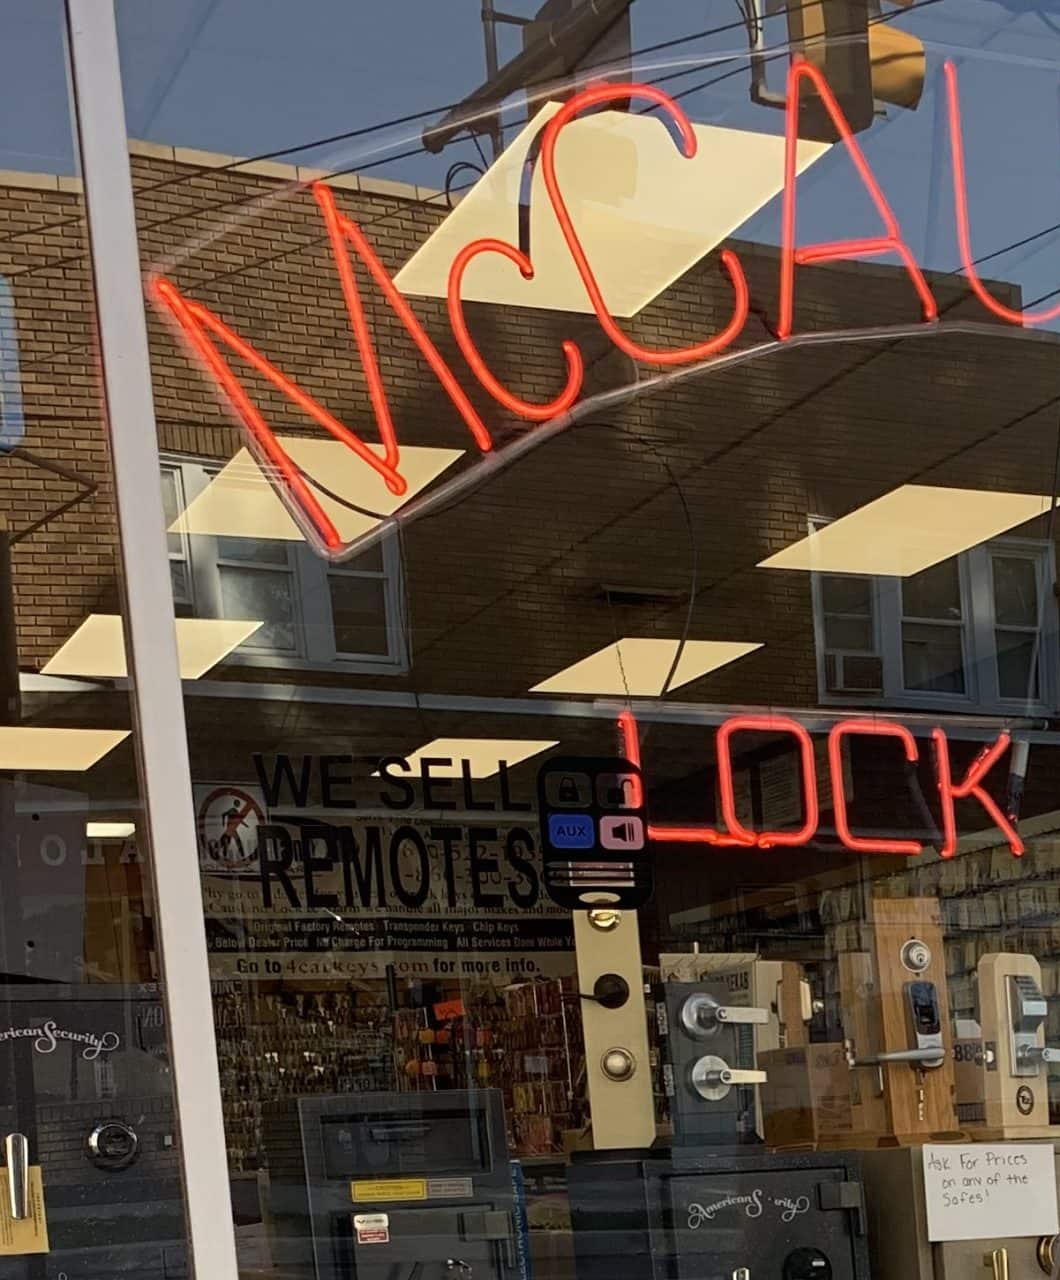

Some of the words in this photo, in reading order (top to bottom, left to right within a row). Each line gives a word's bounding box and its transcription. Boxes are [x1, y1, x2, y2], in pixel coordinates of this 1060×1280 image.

[254, 754, 357, 808] WE
[378, 756, 531, 811] SELL
[618, 710, 1025, 859] LOCK
[555, 825, 587, 837] AUX
[256, 823, 542, 909] REMOTES
[368, 936, 385, 947] For
[236, 958, 259, 973] Go
[264, 958, 282, 973] to
[433, 958, 456, 973] for
[461, 960, 501, 974] more
[505, 958, 541, 973] info.
[928, 1151, 951, 1171] Ask
[959, 1152, 979, 1170] For
[985, 1151, 1028, 1167] Prices
[941, 1177, 956, 1190] on
[986, 1173, 1001, 1186] of
[1006, 1173, 1029, 1185] the
